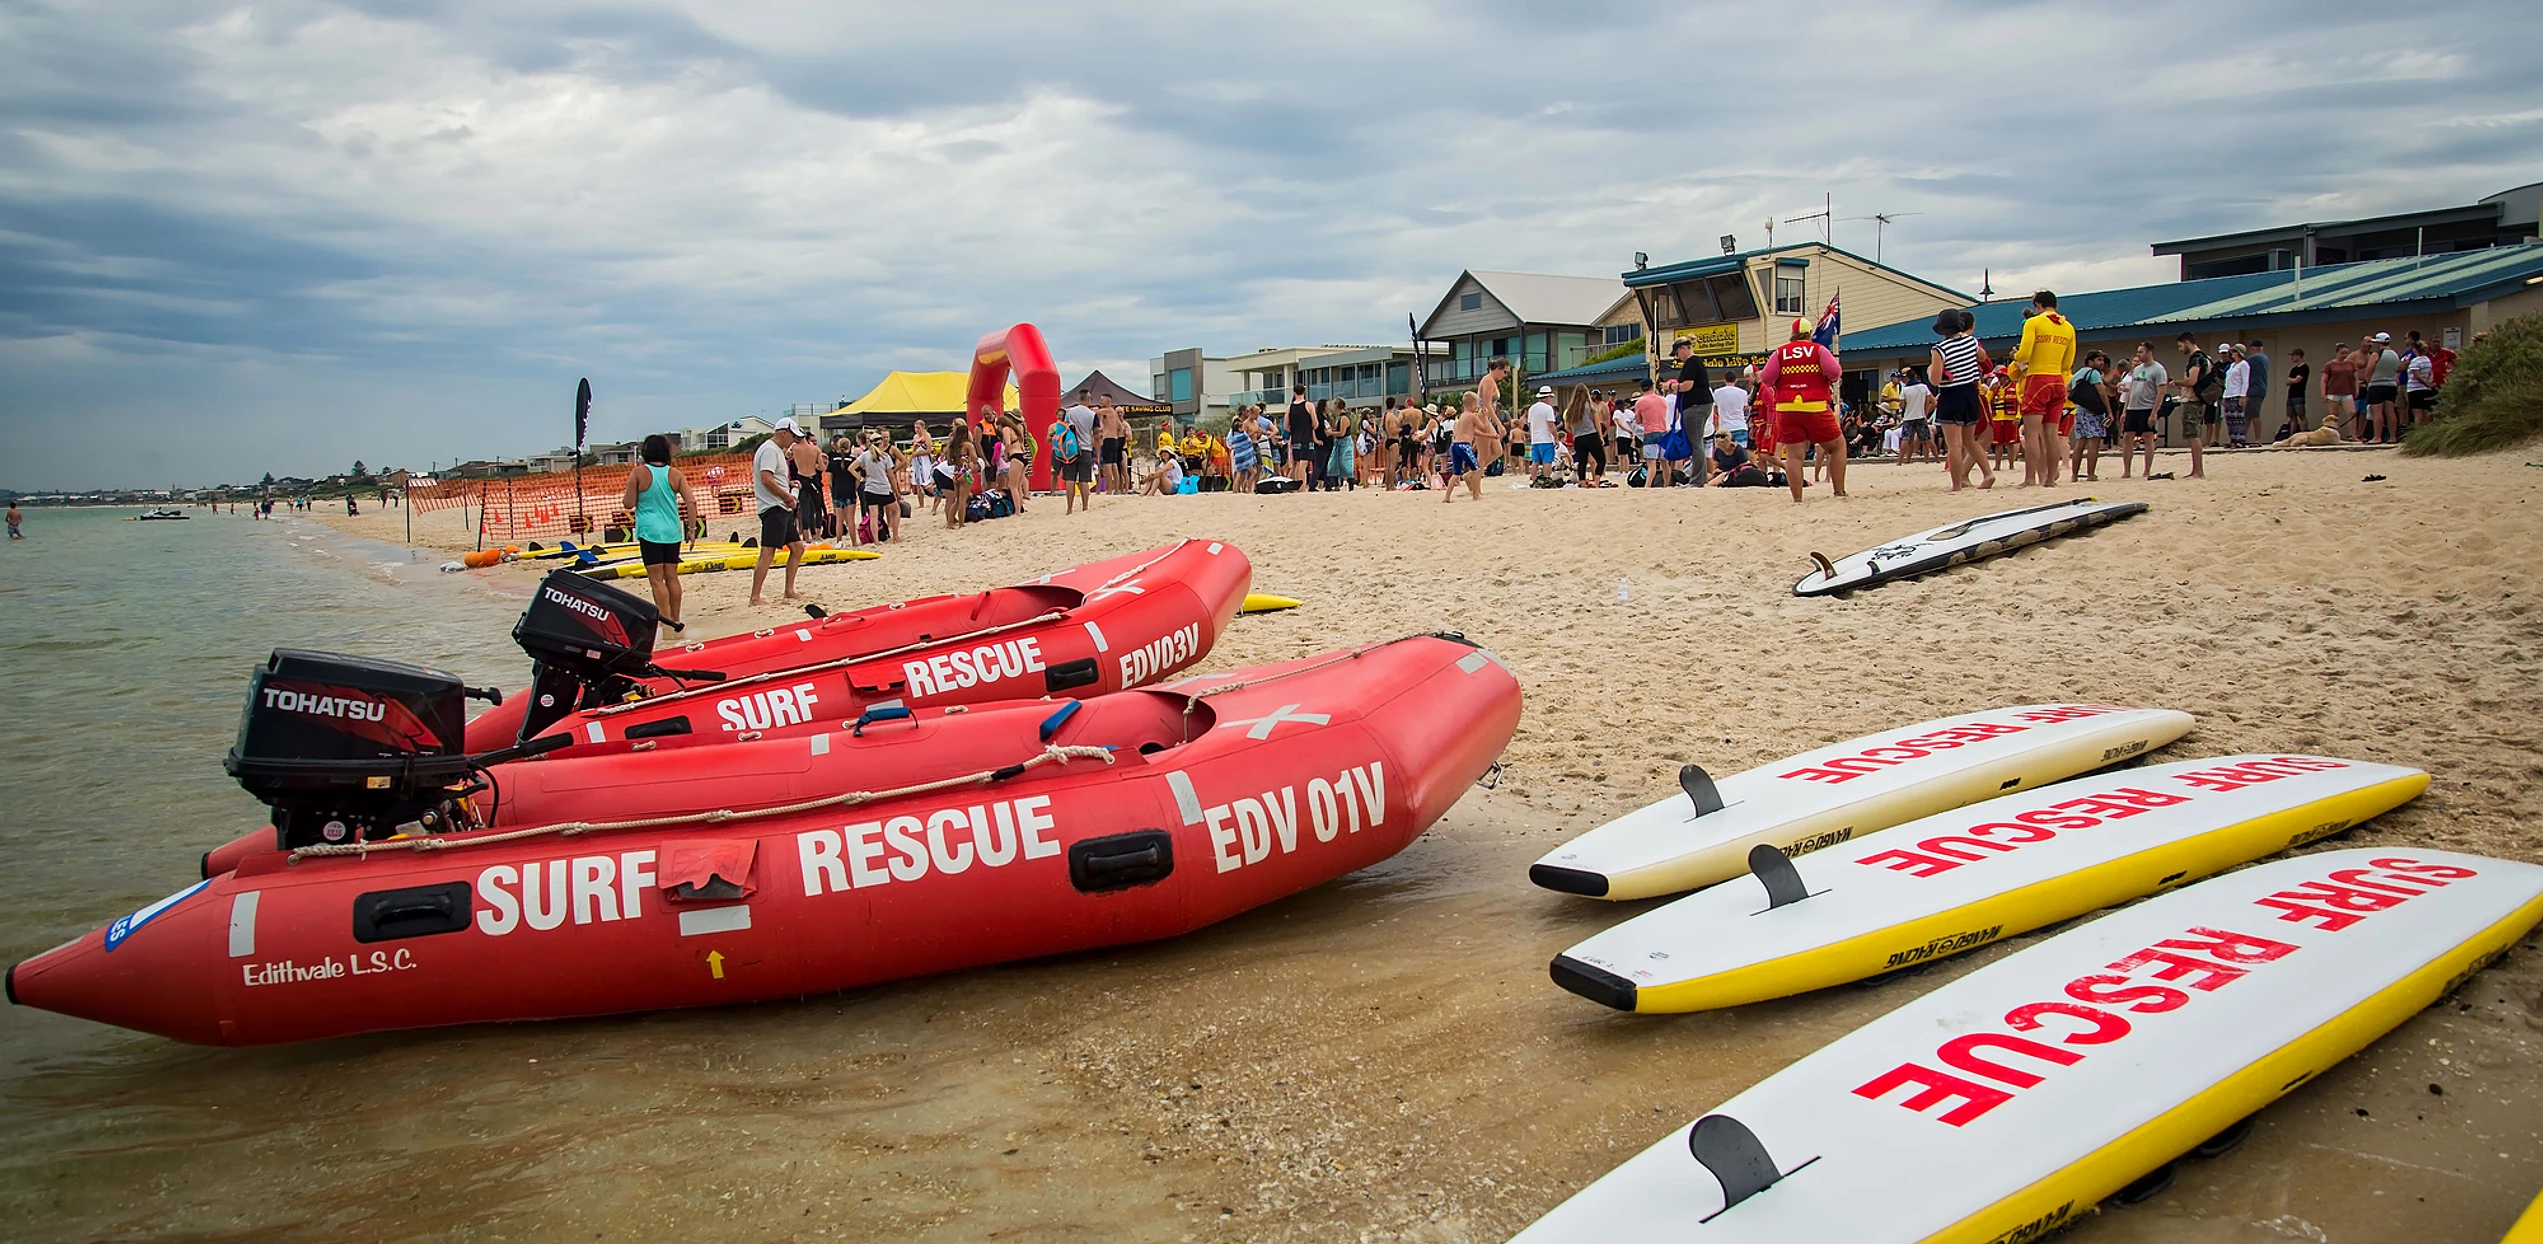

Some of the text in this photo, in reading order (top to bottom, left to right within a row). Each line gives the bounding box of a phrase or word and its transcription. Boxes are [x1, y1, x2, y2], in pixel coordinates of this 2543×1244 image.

[1782, 345, 1815, 361] LSV
[2035, 334, 2053, 344] SURF
[1725, 355, 1749, 367] Life
[1155, 404, 1172, 412] CLUB
[545, 586, 610, 622] TOHATSU
[1119, 622, 1200, 691] EDV03V
[716, 636, 1047, 732] SURF RESCUE
[263, 687, 386, 723] TOHATSU
[1777, 722, 2032, 785] RESCUE
[1203, 760, 1387, 875] EDV 01V
[1854, 757, 2351, 879] SURF RESCUE
[1780, 841, 1803, 857] RAC
[1814, 825, 1855, 851] MANGO
[475, 794, 1062, 937] SURF RESCUE
[1952, 923, 2004, 951] MANGO
[243, 948, 418, 987] Edithvale L.S.C.
[1883, 942, 1939, 970] RACING
[1851, 857, 2479, 1128] SURF RESCUE
